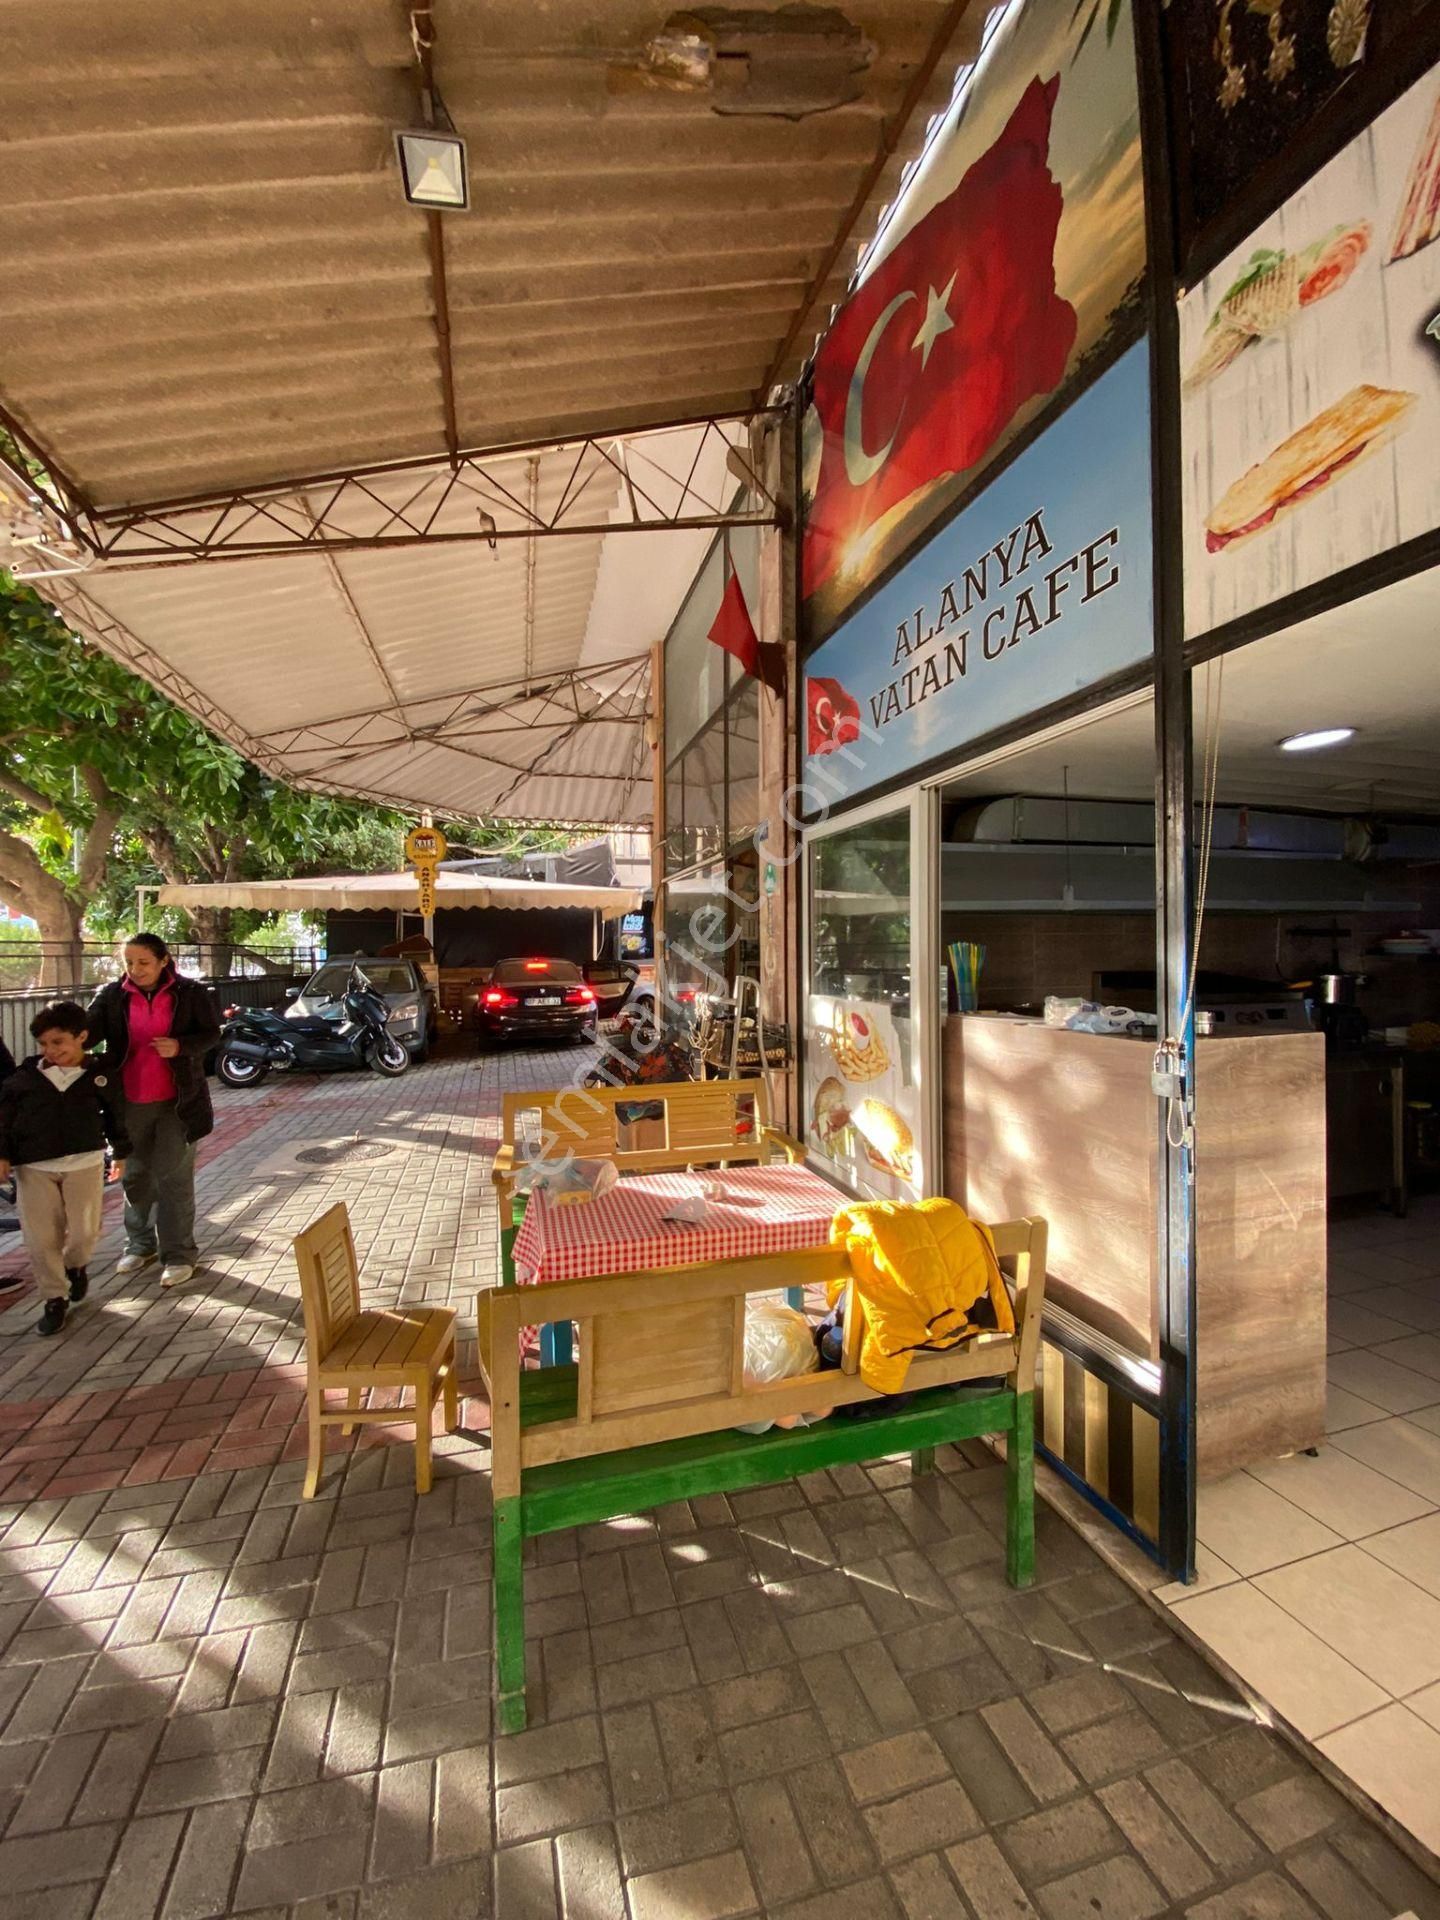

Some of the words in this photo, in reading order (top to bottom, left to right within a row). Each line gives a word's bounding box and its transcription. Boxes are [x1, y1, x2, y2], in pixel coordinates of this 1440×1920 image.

[869, 630, 969, 729] VATAN
[982, 527, 1121, 662] CAFE
[892, 507, 1053, 666] ALANYA
